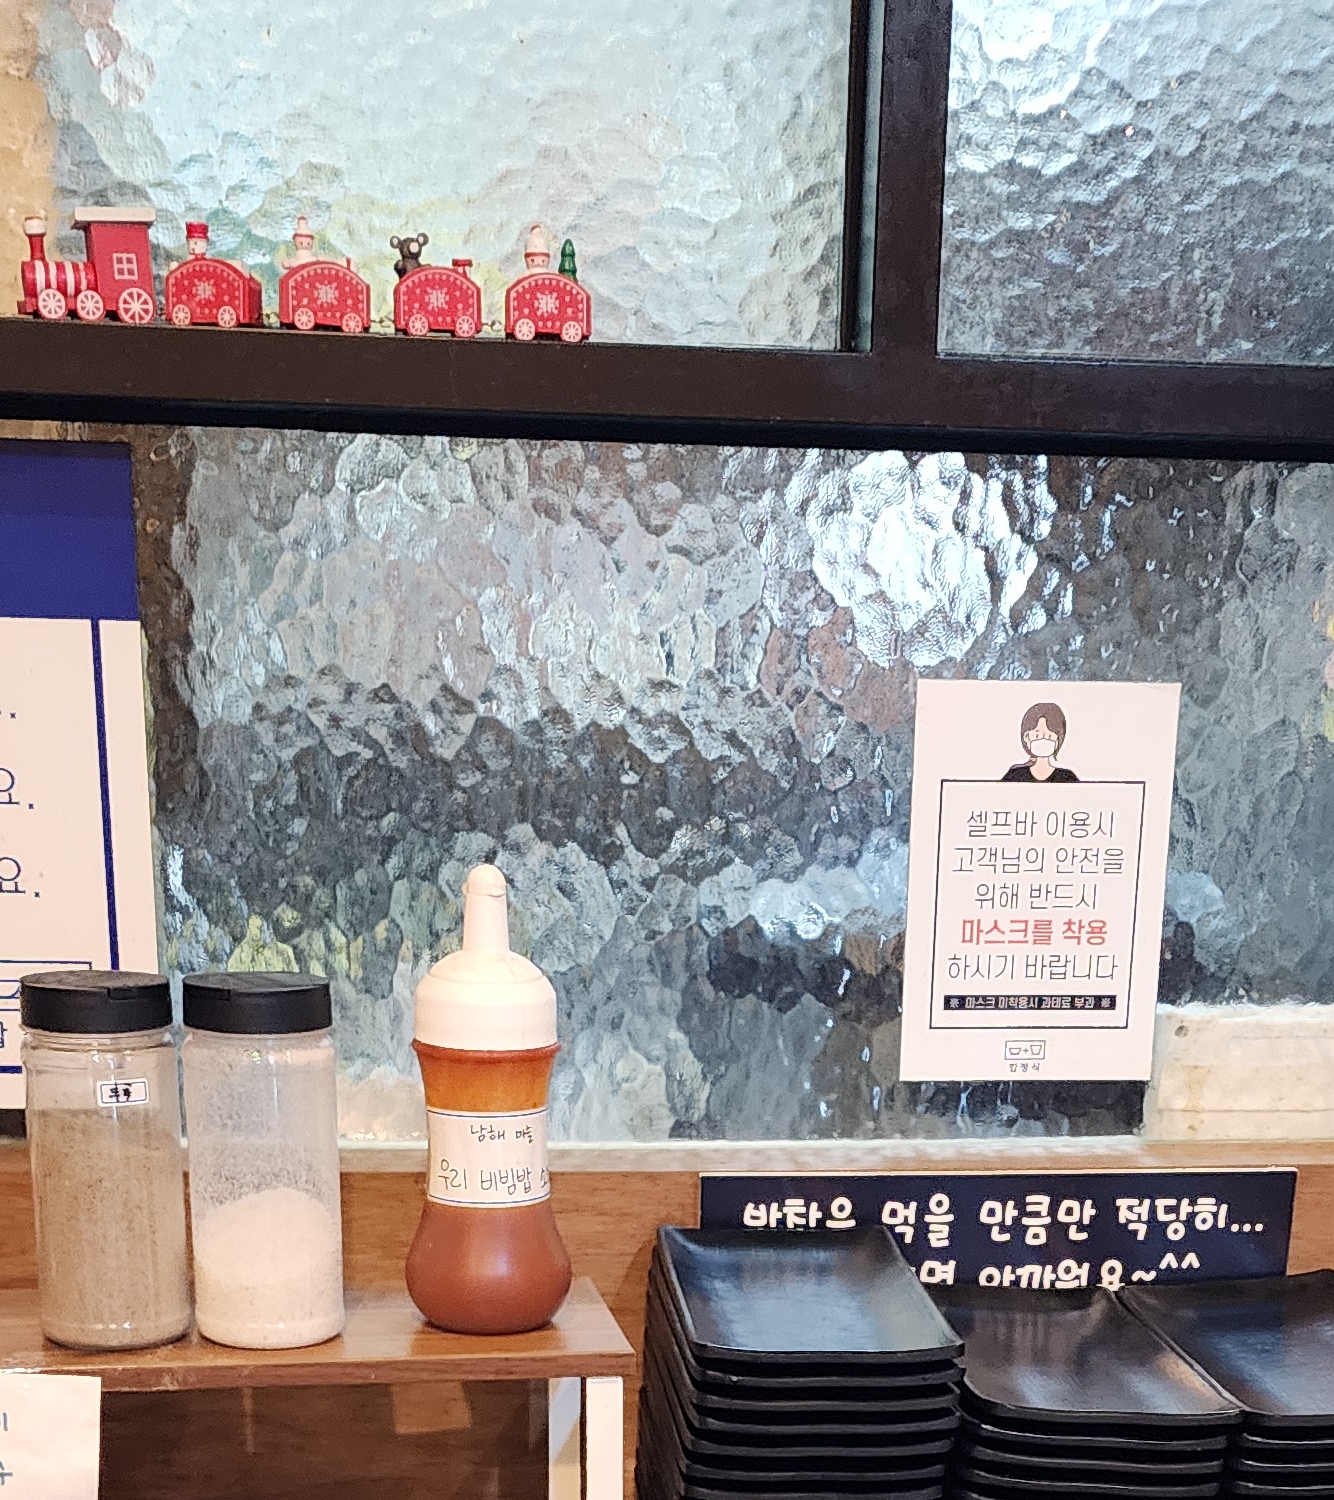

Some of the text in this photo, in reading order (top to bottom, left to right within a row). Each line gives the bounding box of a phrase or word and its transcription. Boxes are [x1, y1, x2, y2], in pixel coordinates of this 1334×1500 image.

[967, 811, 1113, 838] 셀프바 이용시
[953, 847, 1124, 874] 고객님의 안전을
[975, 883, 1097, 909] 위해 반드시
[962, 919, 1107, 945] 마스크를 착용
[948, 954, 1118, 980] 하시기 바랍니다
[965, 996, 996, 1009] 마스크
[437, 1158, 468, 1190] 우리
[481, 1167, 531, 1195] 비빔밥
[879, 1192, 956, 1249] 먹을
[977, 1193, 1096, 1246] 만큼만
